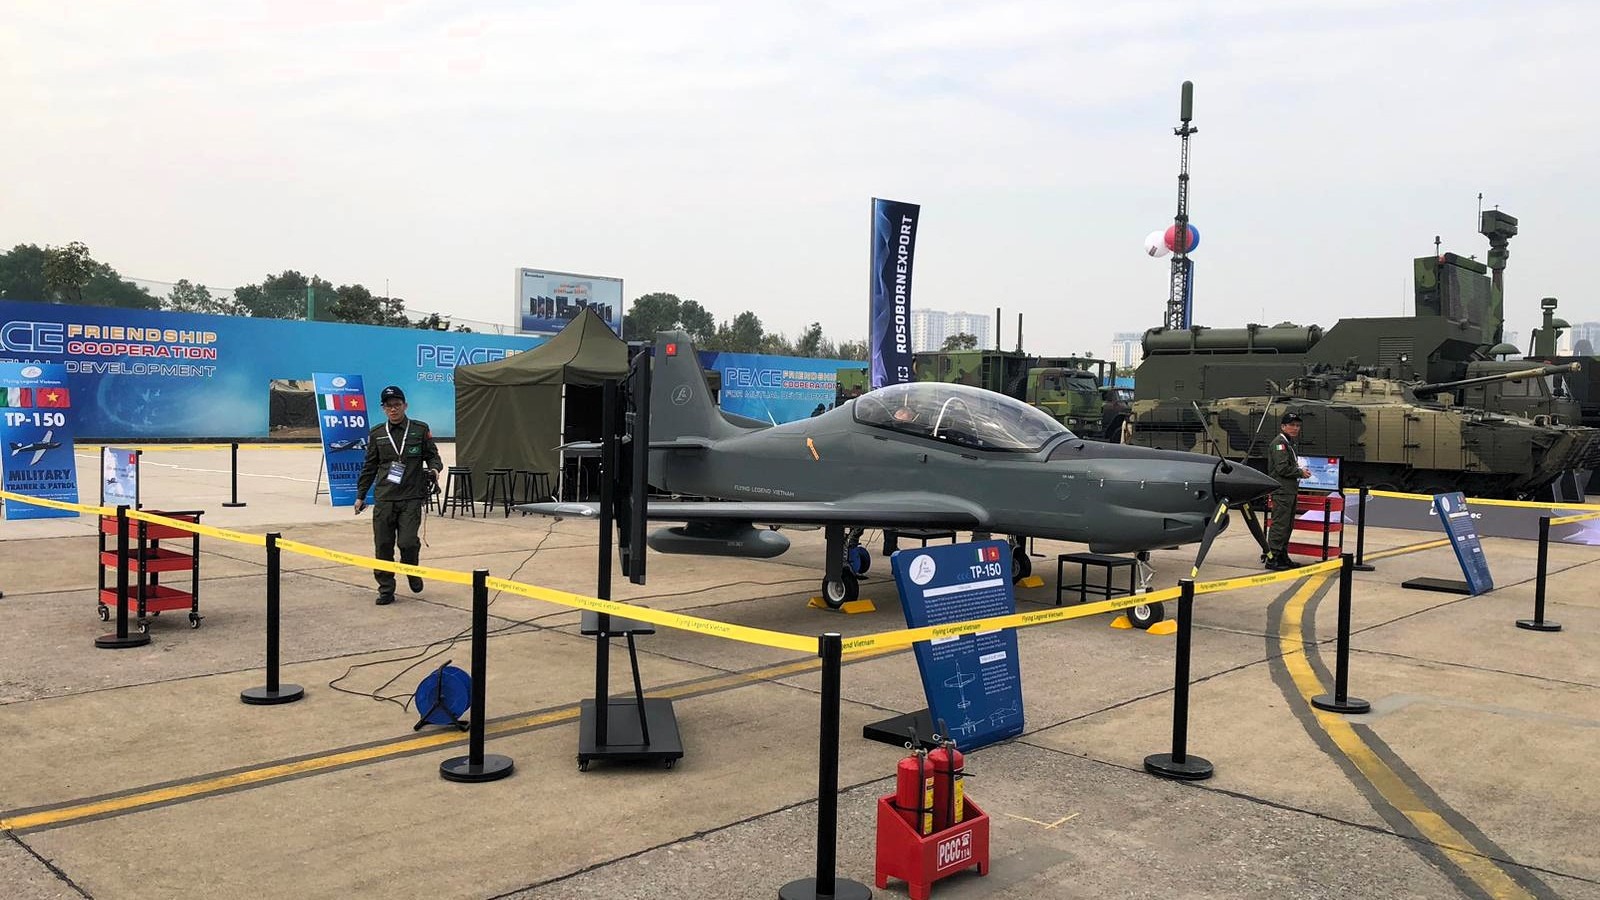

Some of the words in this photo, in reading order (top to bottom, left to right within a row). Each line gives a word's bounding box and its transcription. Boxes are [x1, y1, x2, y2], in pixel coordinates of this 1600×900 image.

[895, 214, 912, 354] ROSOBORNEXPORT
[67, 324, 218, 345] FRIENDSHIP
[67, 342, 217, 359] COOPERATION
[64, 360, 216, 377] DEVELOPMENT
[416, 372, 444, 382] FOR
[725, 367, 782, 388] PEACE
[4, 412, 65, 427] TP-150
[324, 415, 365, 428] TP-150
[9, 469, 71, 481] MILITARY
[6, 483, 39, 491] TRAINER
[47, 482, 76, 490] PATROL
[734, 484, 751, 492] FLYING
[751, 486, 772, 494] LEGEND
[773, 489, 795, 497] VIETNAM
[970, 562, 1002, 579] TP-150
[1022, 614, 1034, 622] Flying
[1034, 612, 1047, 621] Legend
[1048, 610, 1064, 618] Vietnam
[691, 621, 709, 632] Legend
[709, 623, 731, 632] Vietnam
[932, 627, 946, 636] Flying
[947, 625, 963, 634] Legend
[963, 623, 981, 631] Vietnam
[853, 638, 875, 648] Vietnam
[939, 838, 961, 867] PCCC
